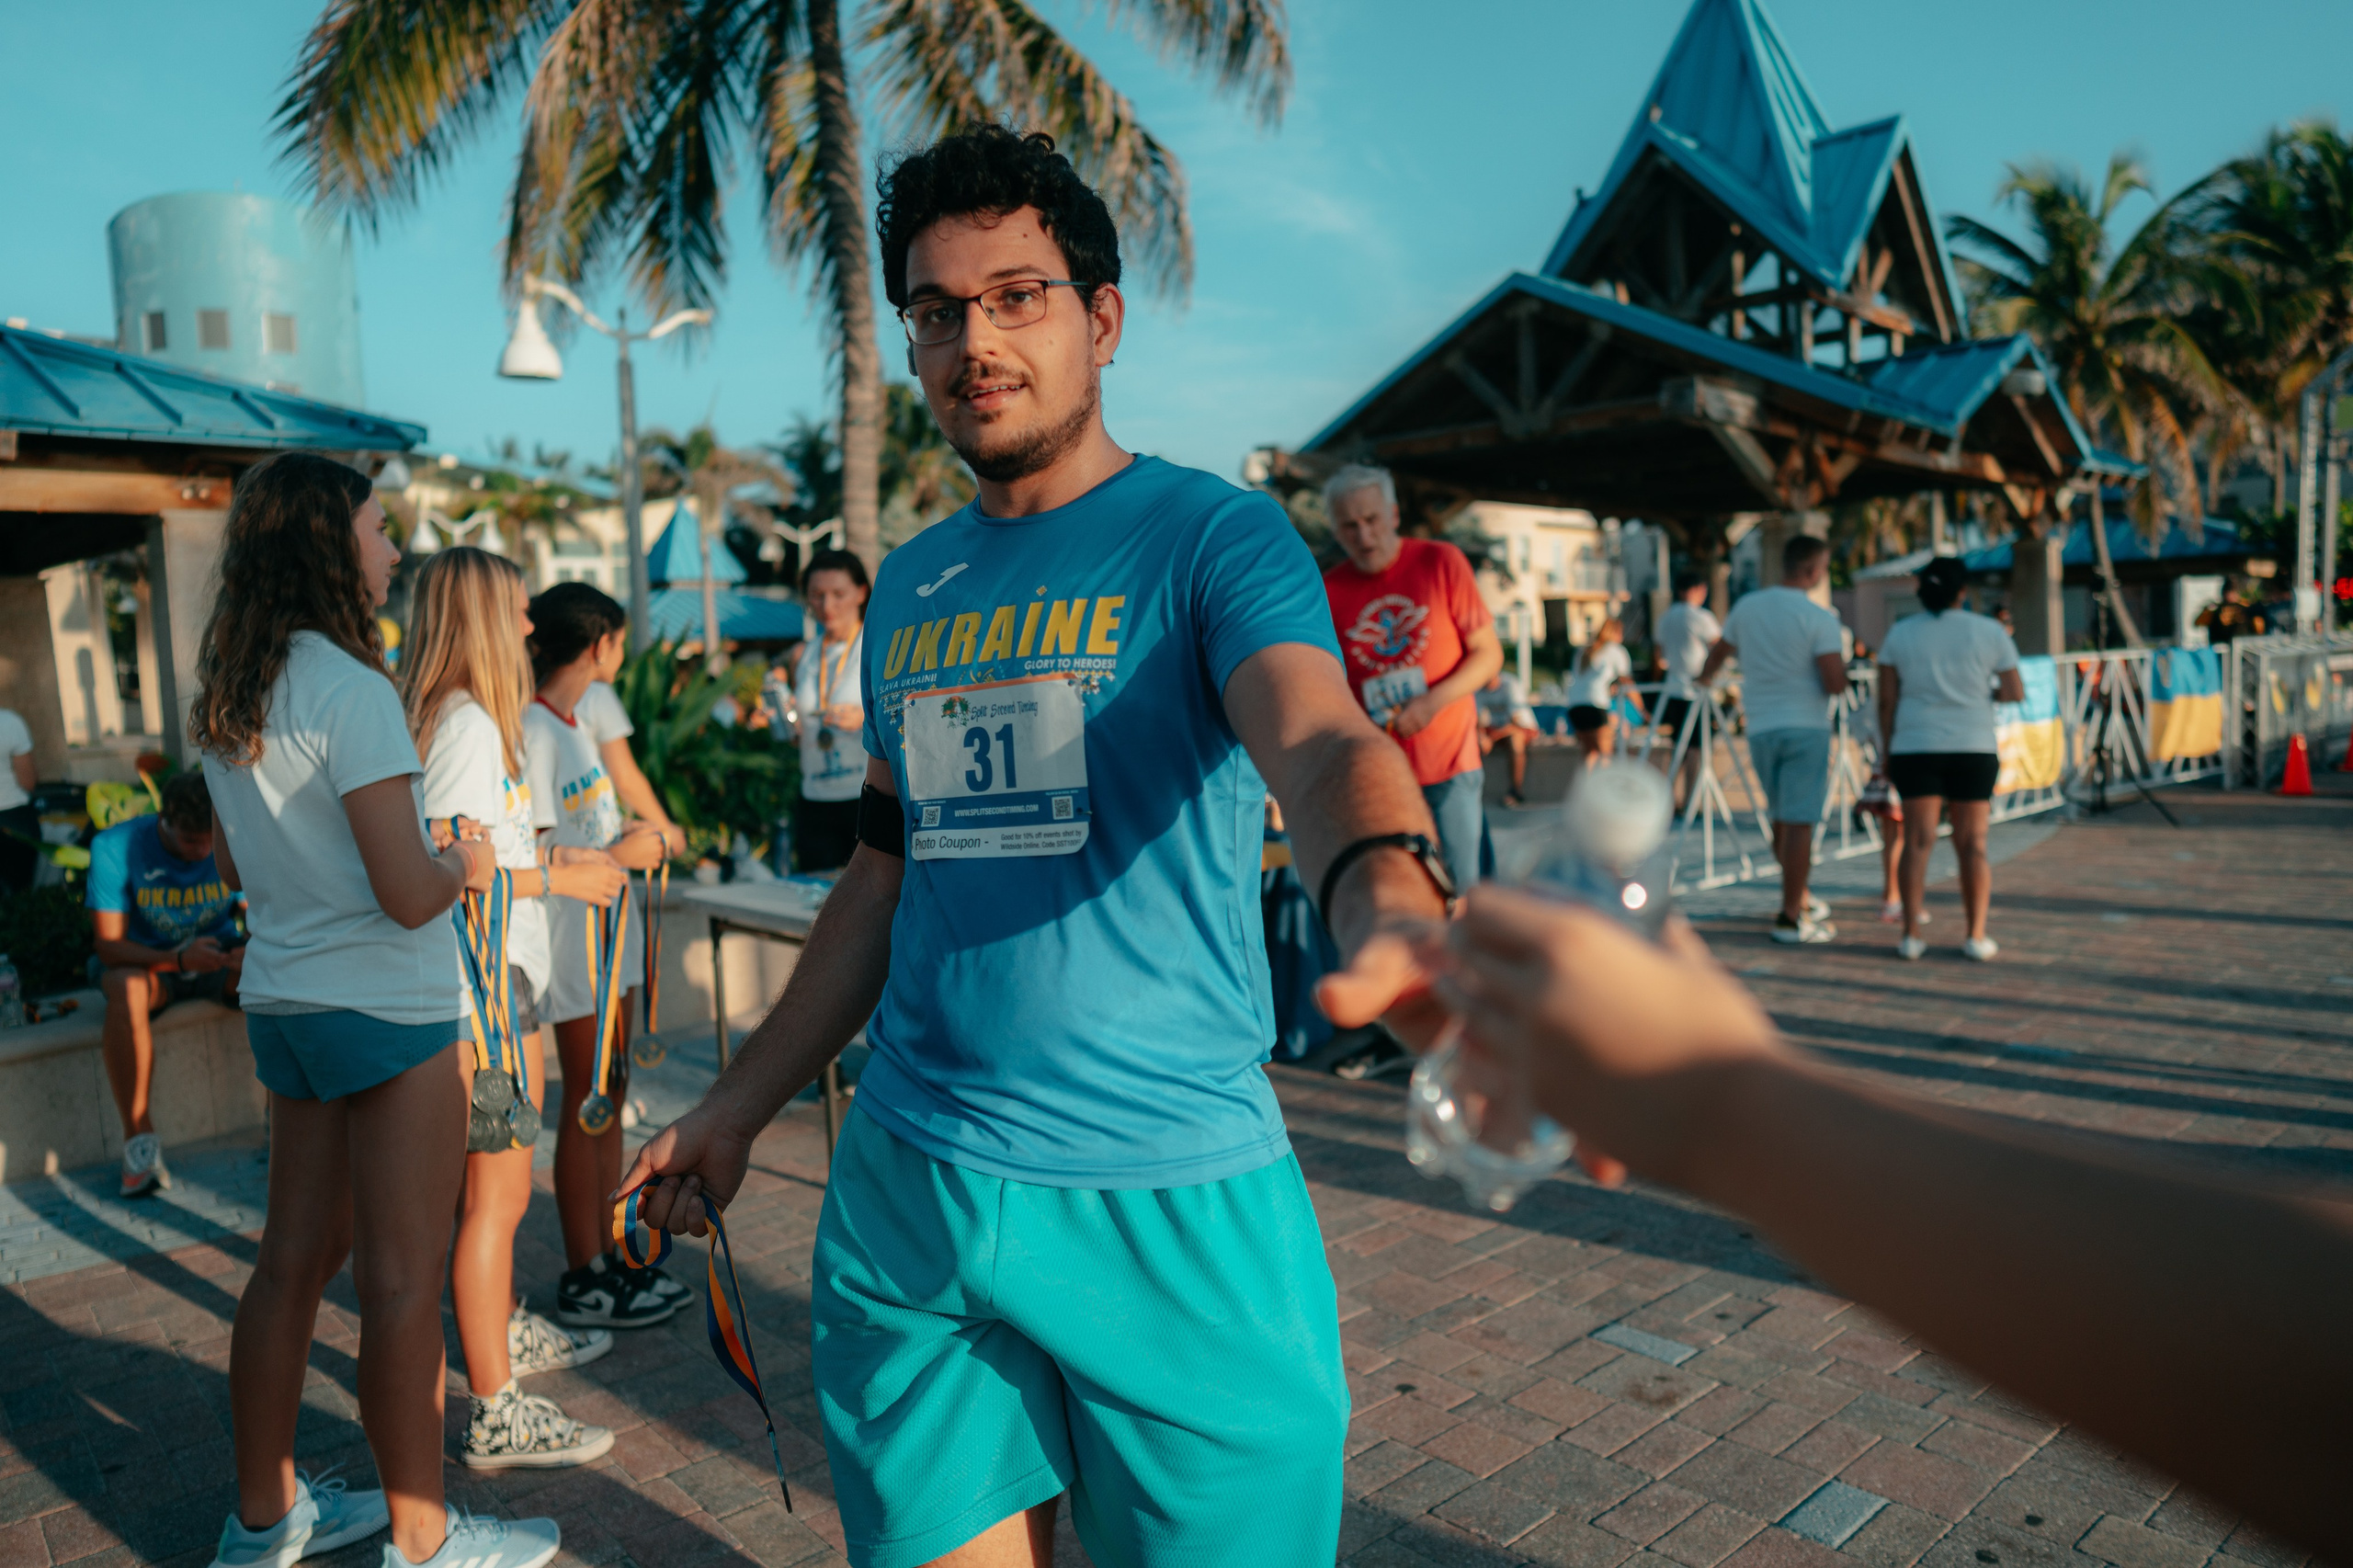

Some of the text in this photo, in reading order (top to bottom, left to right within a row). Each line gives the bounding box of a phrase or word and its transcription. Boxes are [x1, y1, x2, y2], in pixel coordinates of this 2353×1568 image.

[883, 595, 1127, 681] UKRAINE
[1024, 657, 1117, 671] GLORY TO HEROES!
[880, 673, 938, 695] SLAVA UKRAINI!
[971, 699, 1039, 722] Split Second Timing
[963, 722, 1017, 793] 31
[954, 804, 1040, 817] WWW.SPLITSECONDTIMING.COM
[938, 835, 982, 851] Coupon
[1001, 833, 1014, 841] Good
[1023, 832, 1034, 840] 10%
[1035, 831, 1043, 839] off
[1043, 831, 1061, 839] events
[1075, 829, 1082, 837] by
[1000, 842, 1022, 850] Wildside
[1041, 840, 1056, 848] Code
